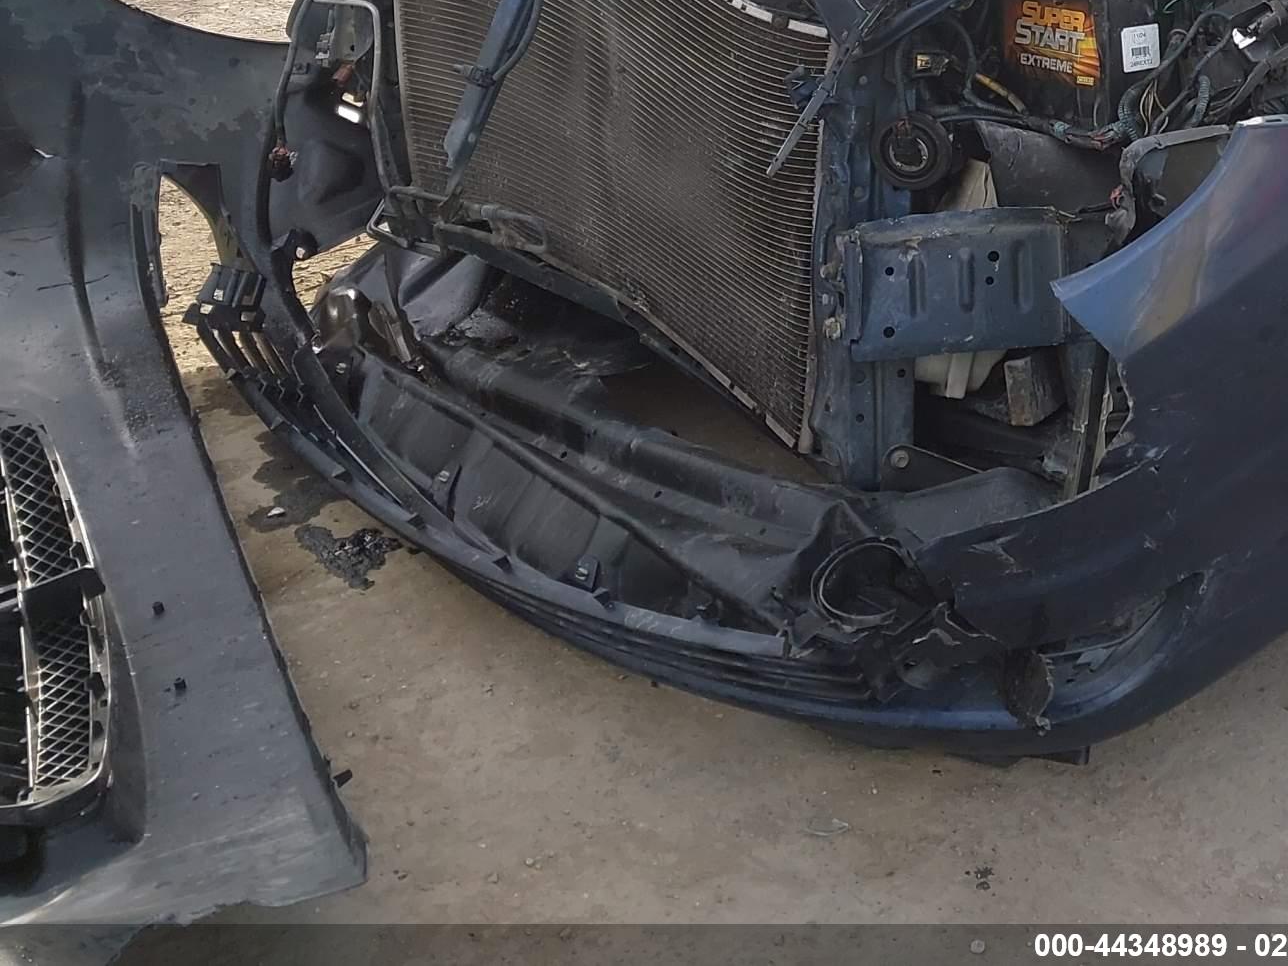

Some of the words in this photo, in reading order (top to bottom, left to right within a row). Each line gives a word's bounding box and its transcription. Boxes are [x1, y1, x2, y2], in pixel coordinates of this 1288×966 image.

[1021, 0, 1086, 32] SUPER
[1014, 17, 1086, 53] START
[1020, 53, 1074, 74] EXTREME
